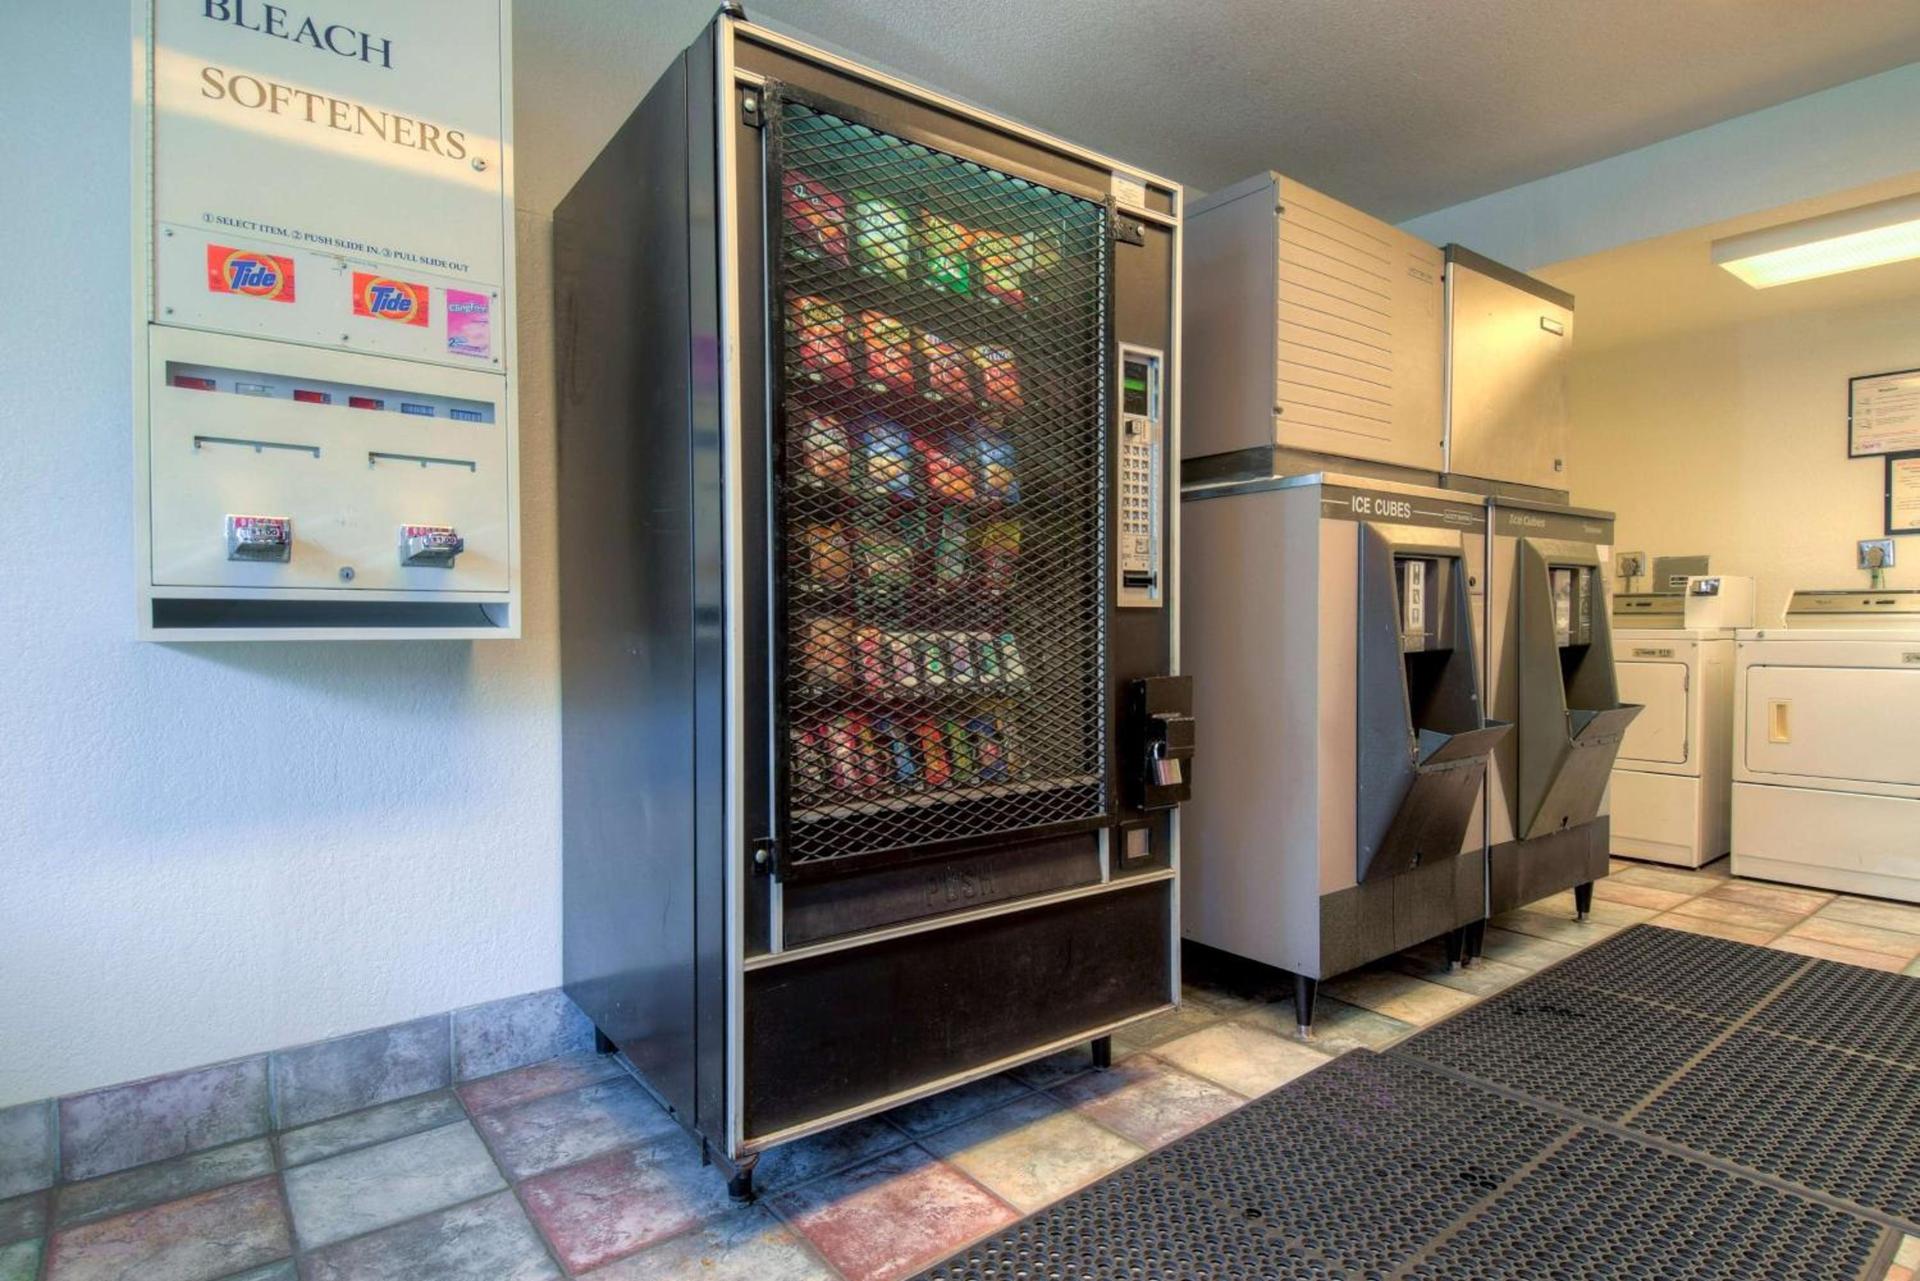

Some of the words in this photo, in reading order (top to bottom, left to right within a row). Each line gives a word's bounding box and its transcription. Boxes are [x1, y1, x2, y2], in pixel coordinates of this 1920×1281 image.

[202, 0, 395, 70] BLEACH
[200, 66, 468, 161] SOFTENERS
[216, 215, 257, 231] SELECT
[304, 233, 333, 246] PUSH
[335, 238, 364, 252] SLIDE
[394, 251, 418, 263] PULL
[419, 255, 447, 269] SLIDE
[448, 262, 470, 273] OUT
[229, 260, 277, 290] Tide
[371, 286, 412, 312] Tide
[1352, 495, 1371, 514] ICE
[1375, 498, 1412, 519] CUBES
[924, 863, 997, 907] PUSH
